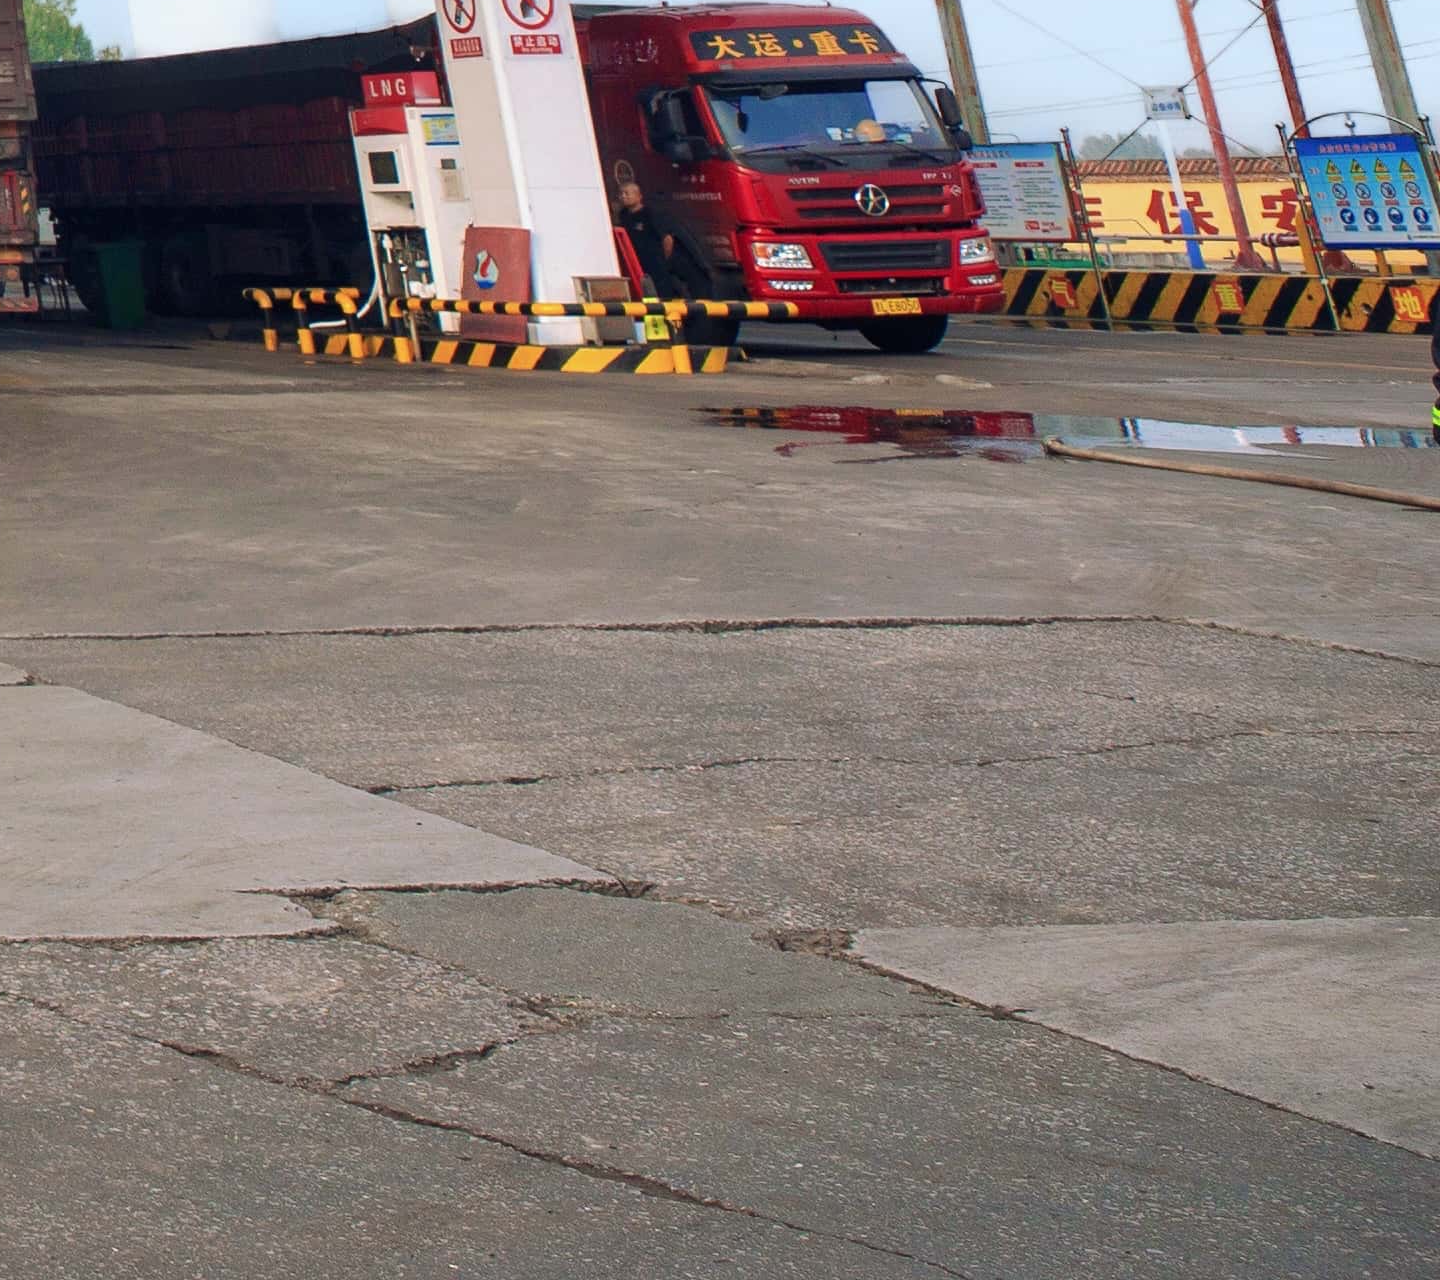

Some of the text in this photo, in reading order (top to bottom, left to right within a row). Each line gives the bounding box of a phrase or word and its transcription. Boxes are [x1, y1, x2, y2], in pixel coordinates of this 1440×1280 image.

[369, 79, 406, 97] LNG
[1216, 285, 1241, 311] 重
[1395, 288, 1423, 318] 地
